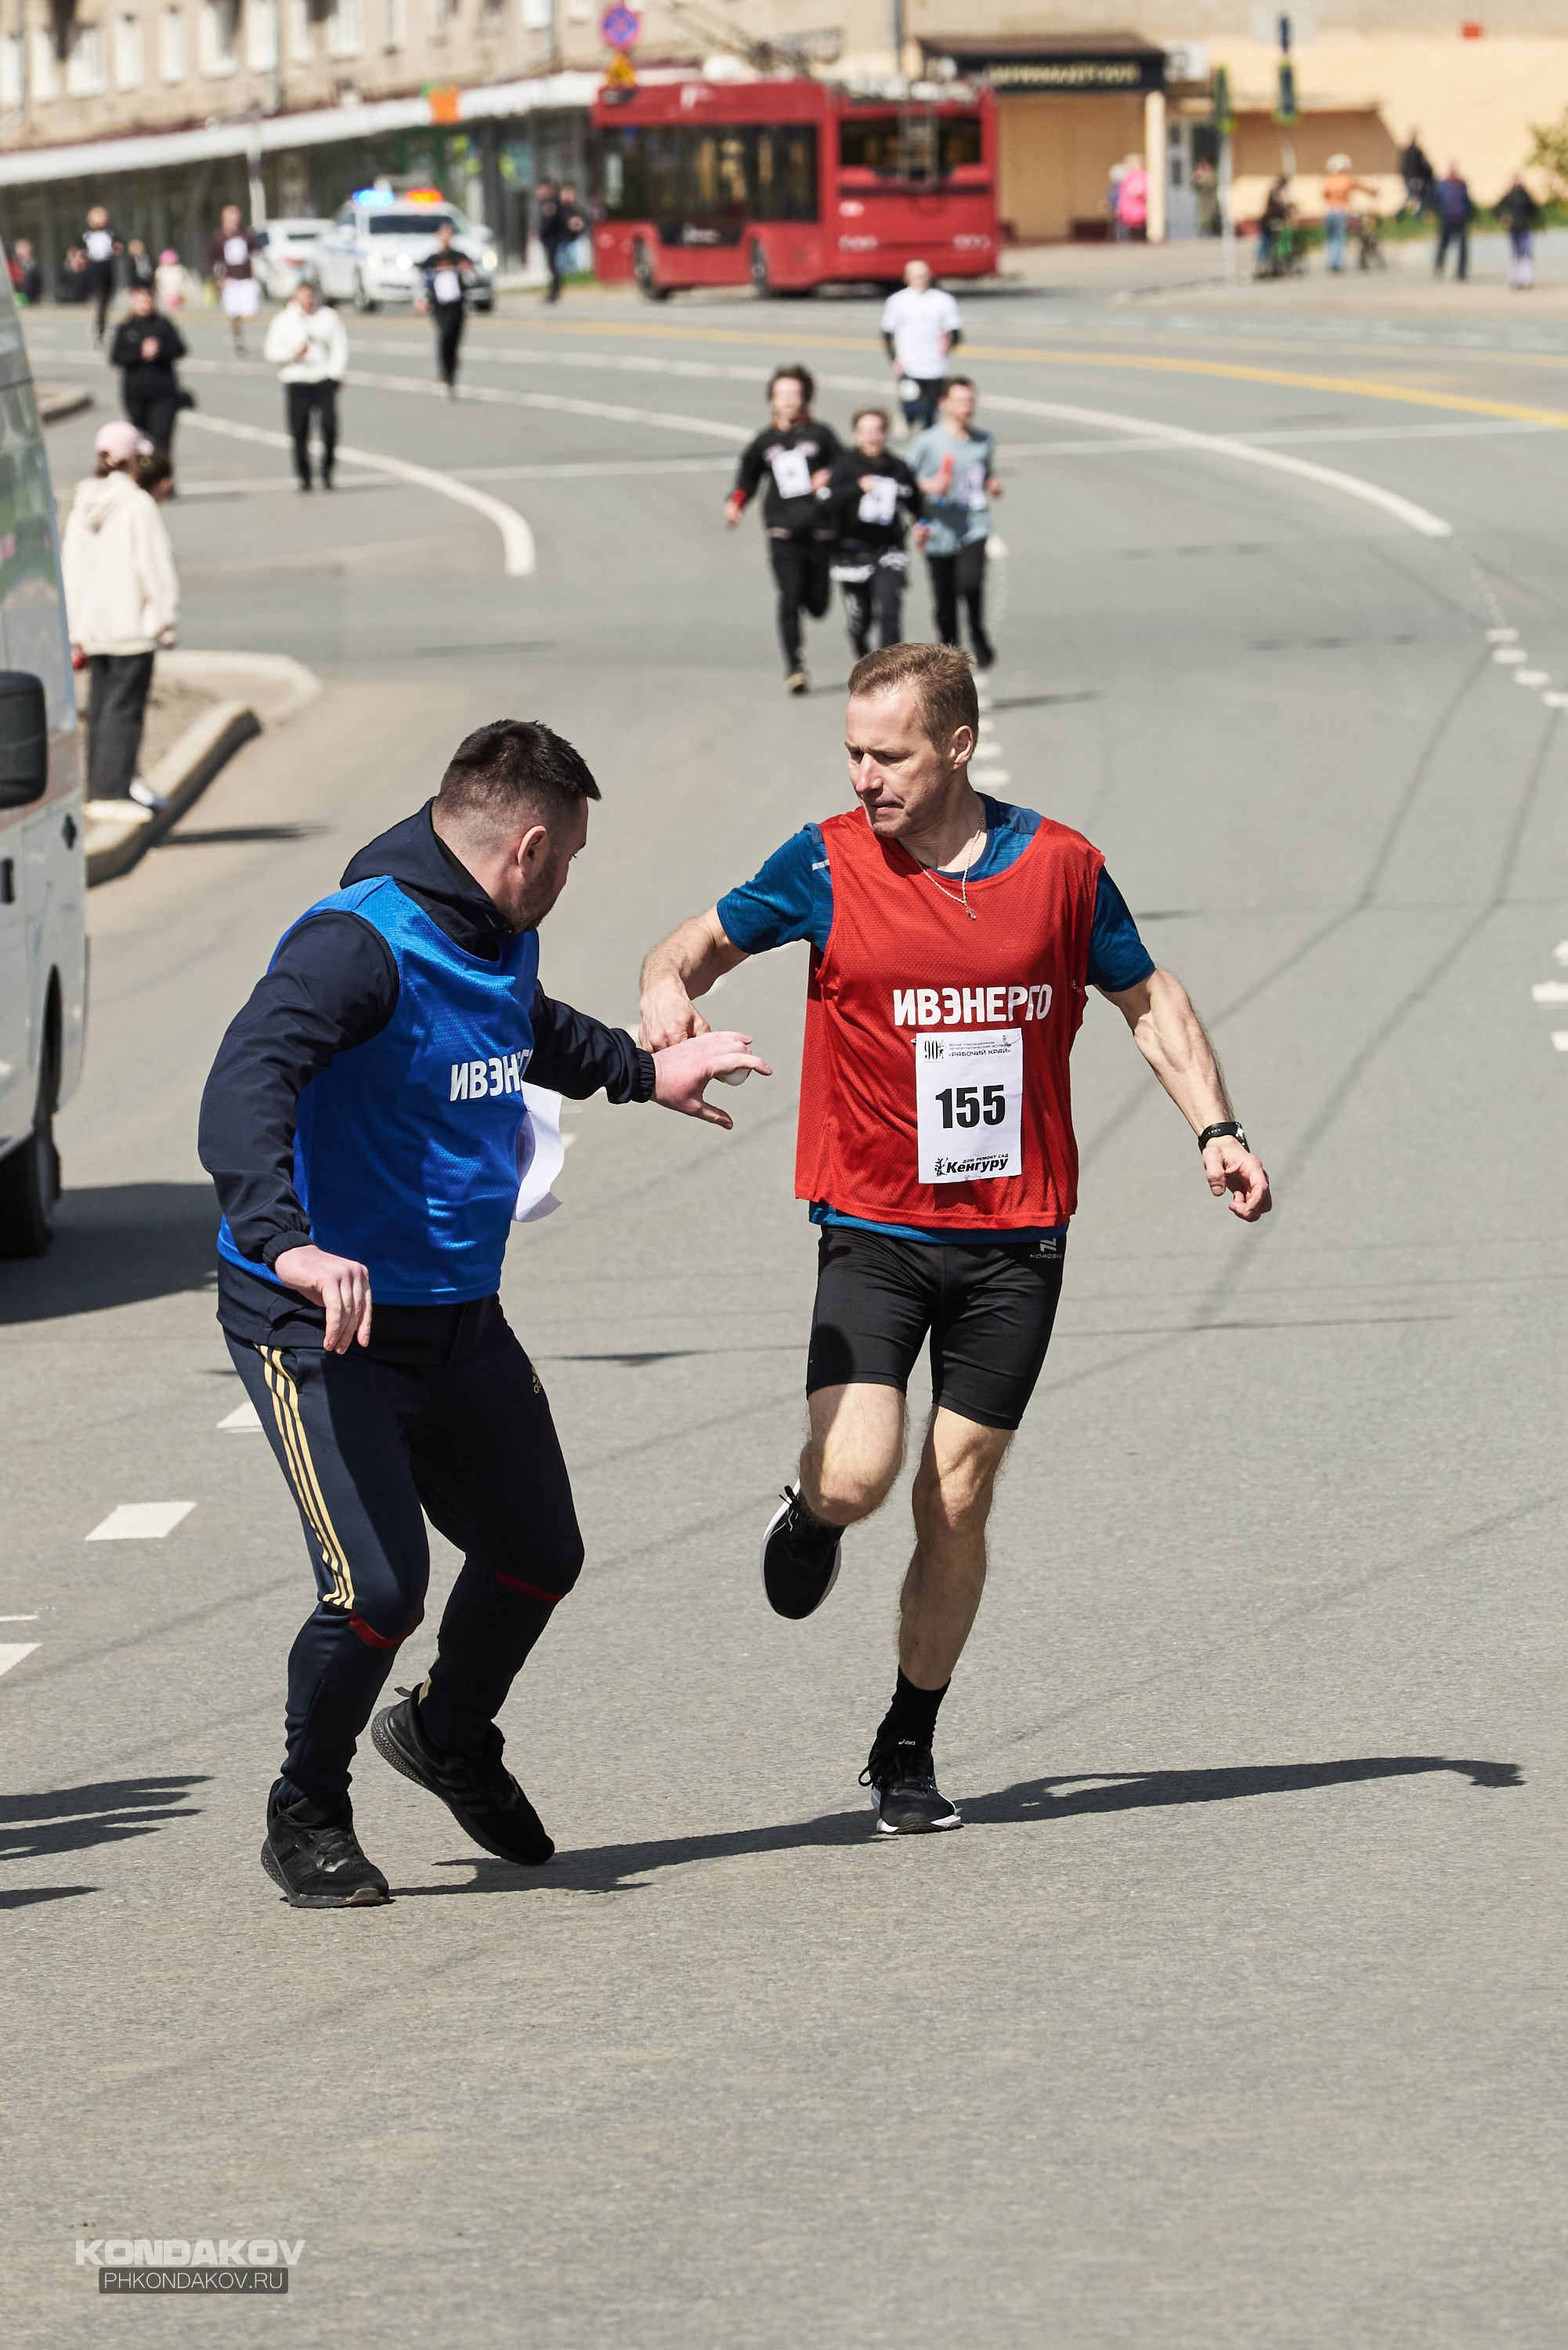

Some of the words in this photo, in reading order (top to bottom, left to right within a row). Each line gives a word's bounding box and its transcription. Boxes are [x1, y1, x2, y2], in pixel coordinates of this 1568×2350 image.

[893, 984, 1053, 1025] ИВЭНЕРГО
[935, 1085, 1005, 1128] 155
[946, 1159, 1009, 1173] Кенгуру
